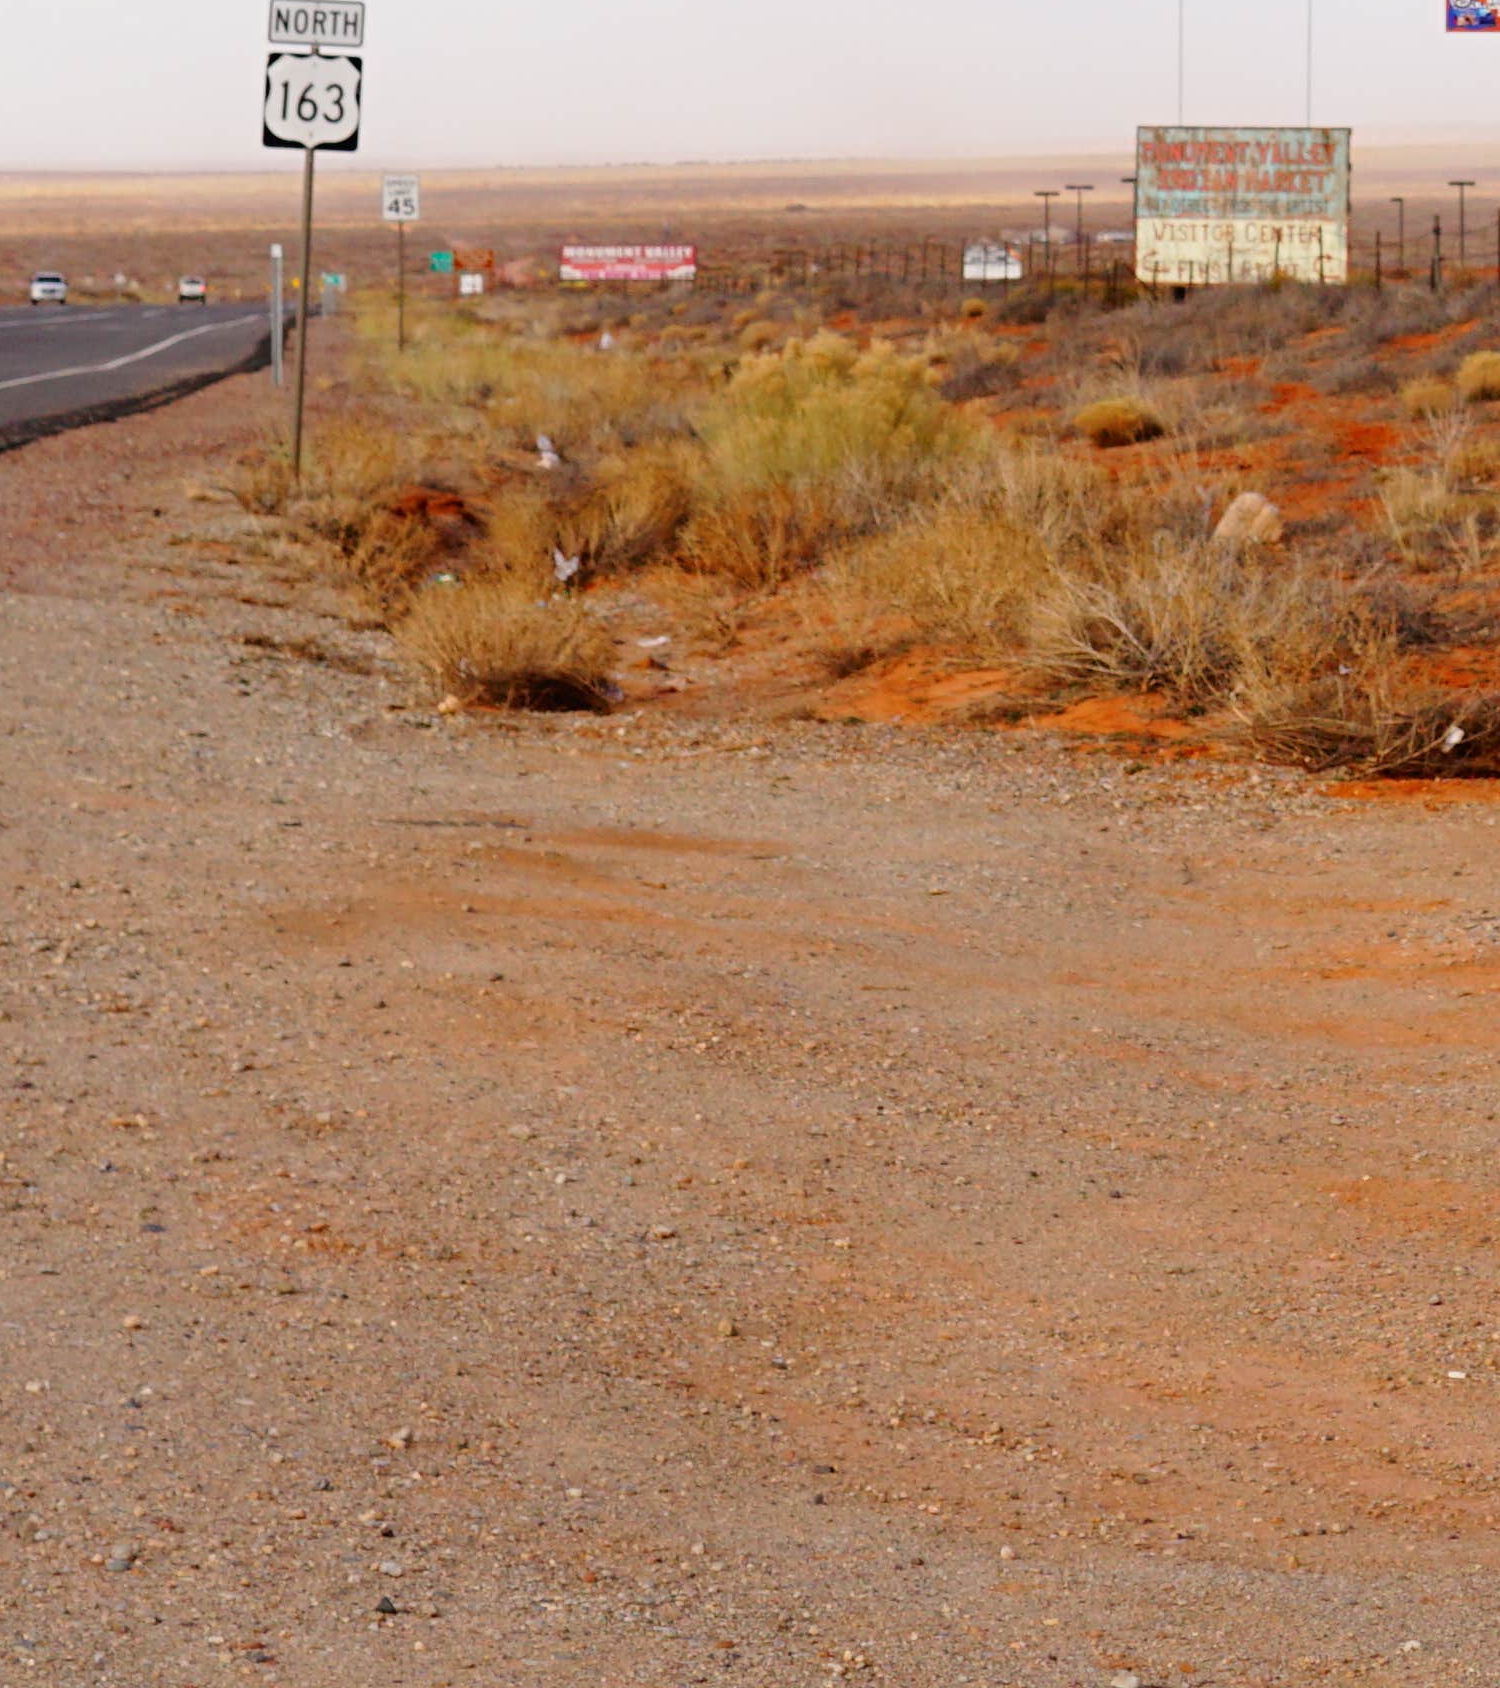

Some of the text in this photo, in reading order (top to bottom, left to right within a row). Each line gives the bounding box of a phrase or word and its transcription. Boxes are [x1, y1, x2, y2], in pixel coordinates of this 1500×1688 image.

[274, 8, 359, 37] NORTH
[280, 80, 345, 124] 163
[387, 198, 416, 216] 45
[1153, 222, 1321, 244] VISITOR CENTER
